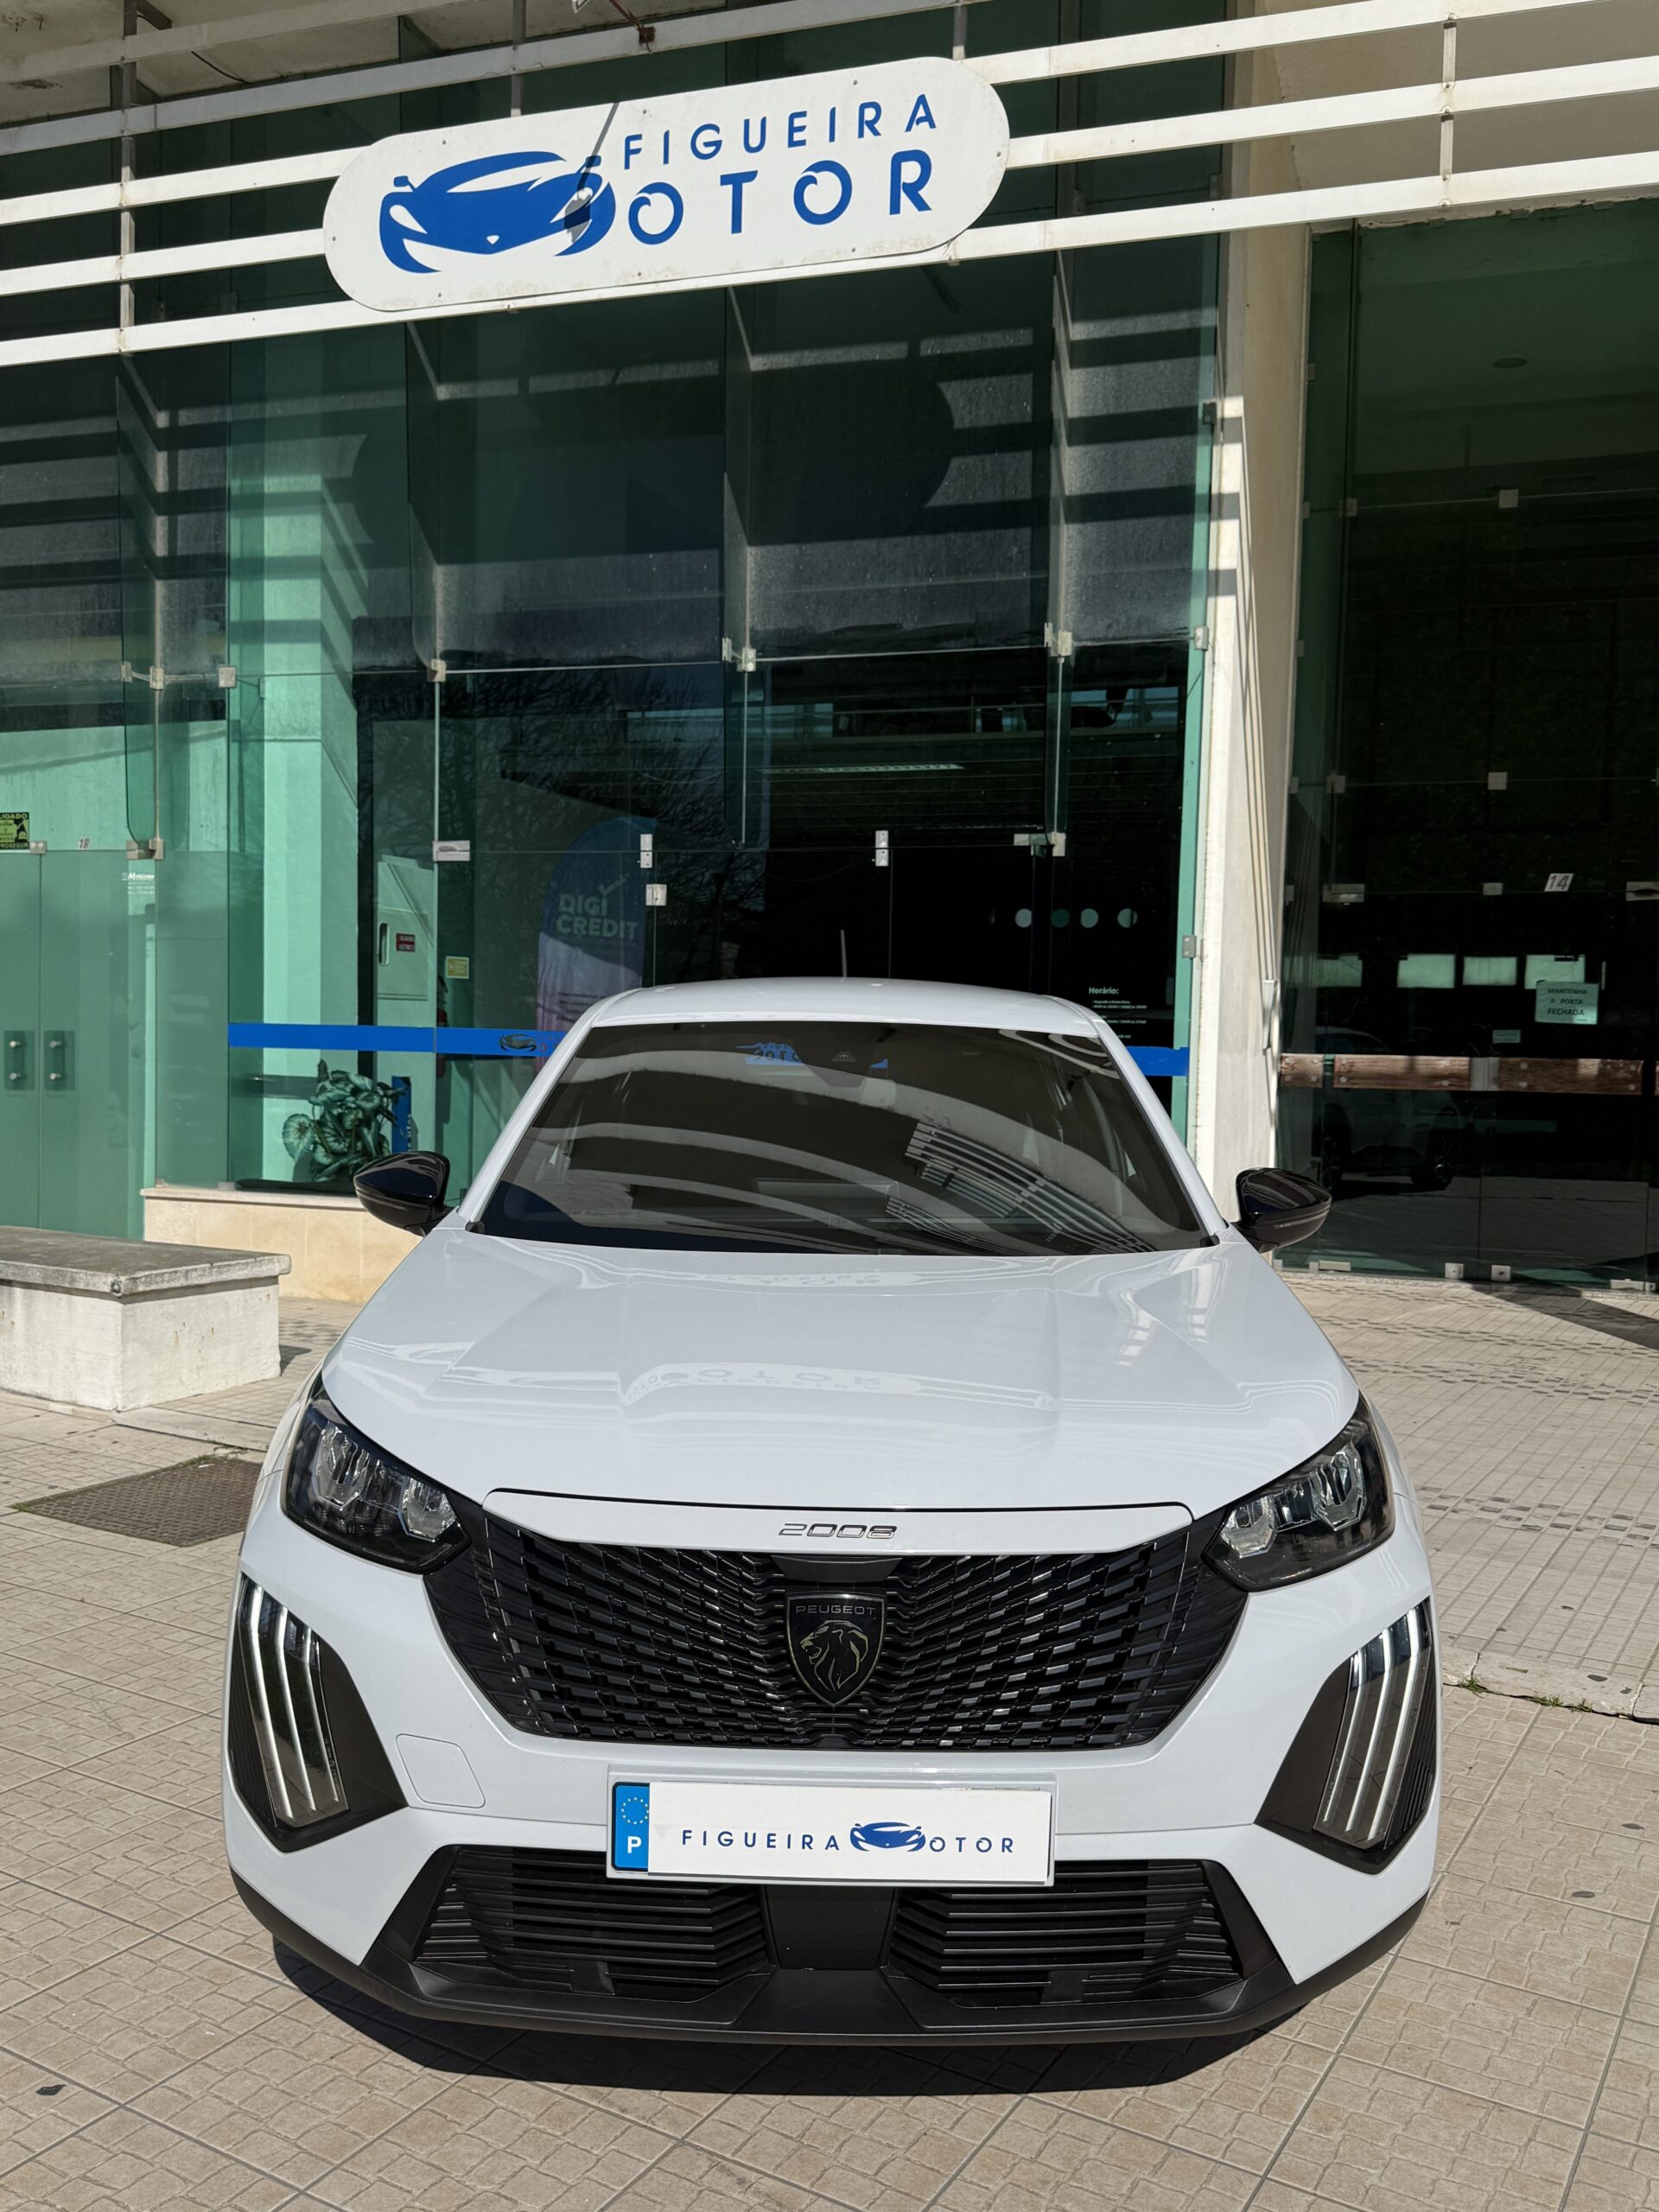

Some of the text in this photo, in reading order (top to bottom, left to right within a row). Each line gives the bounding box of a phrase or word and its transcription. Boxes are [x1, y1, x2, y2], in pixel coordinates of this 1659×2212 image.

[624, 93, 937, 170] FIGUEIRA
[1549, 874, 1570, 890] 14
[559, 893, 608, 917] DIGI
[556, 915, 639, 940] CREDIT
[1547, 1007, 1585, 1016] FECHADA
[779, 1523, 898, 1540] 2008
[796, 1605, 876, 1616] PEUGEOT
[627, 1835, 642, 1853] P
[682, 1829, 840, 1851] FIGUEIRA
